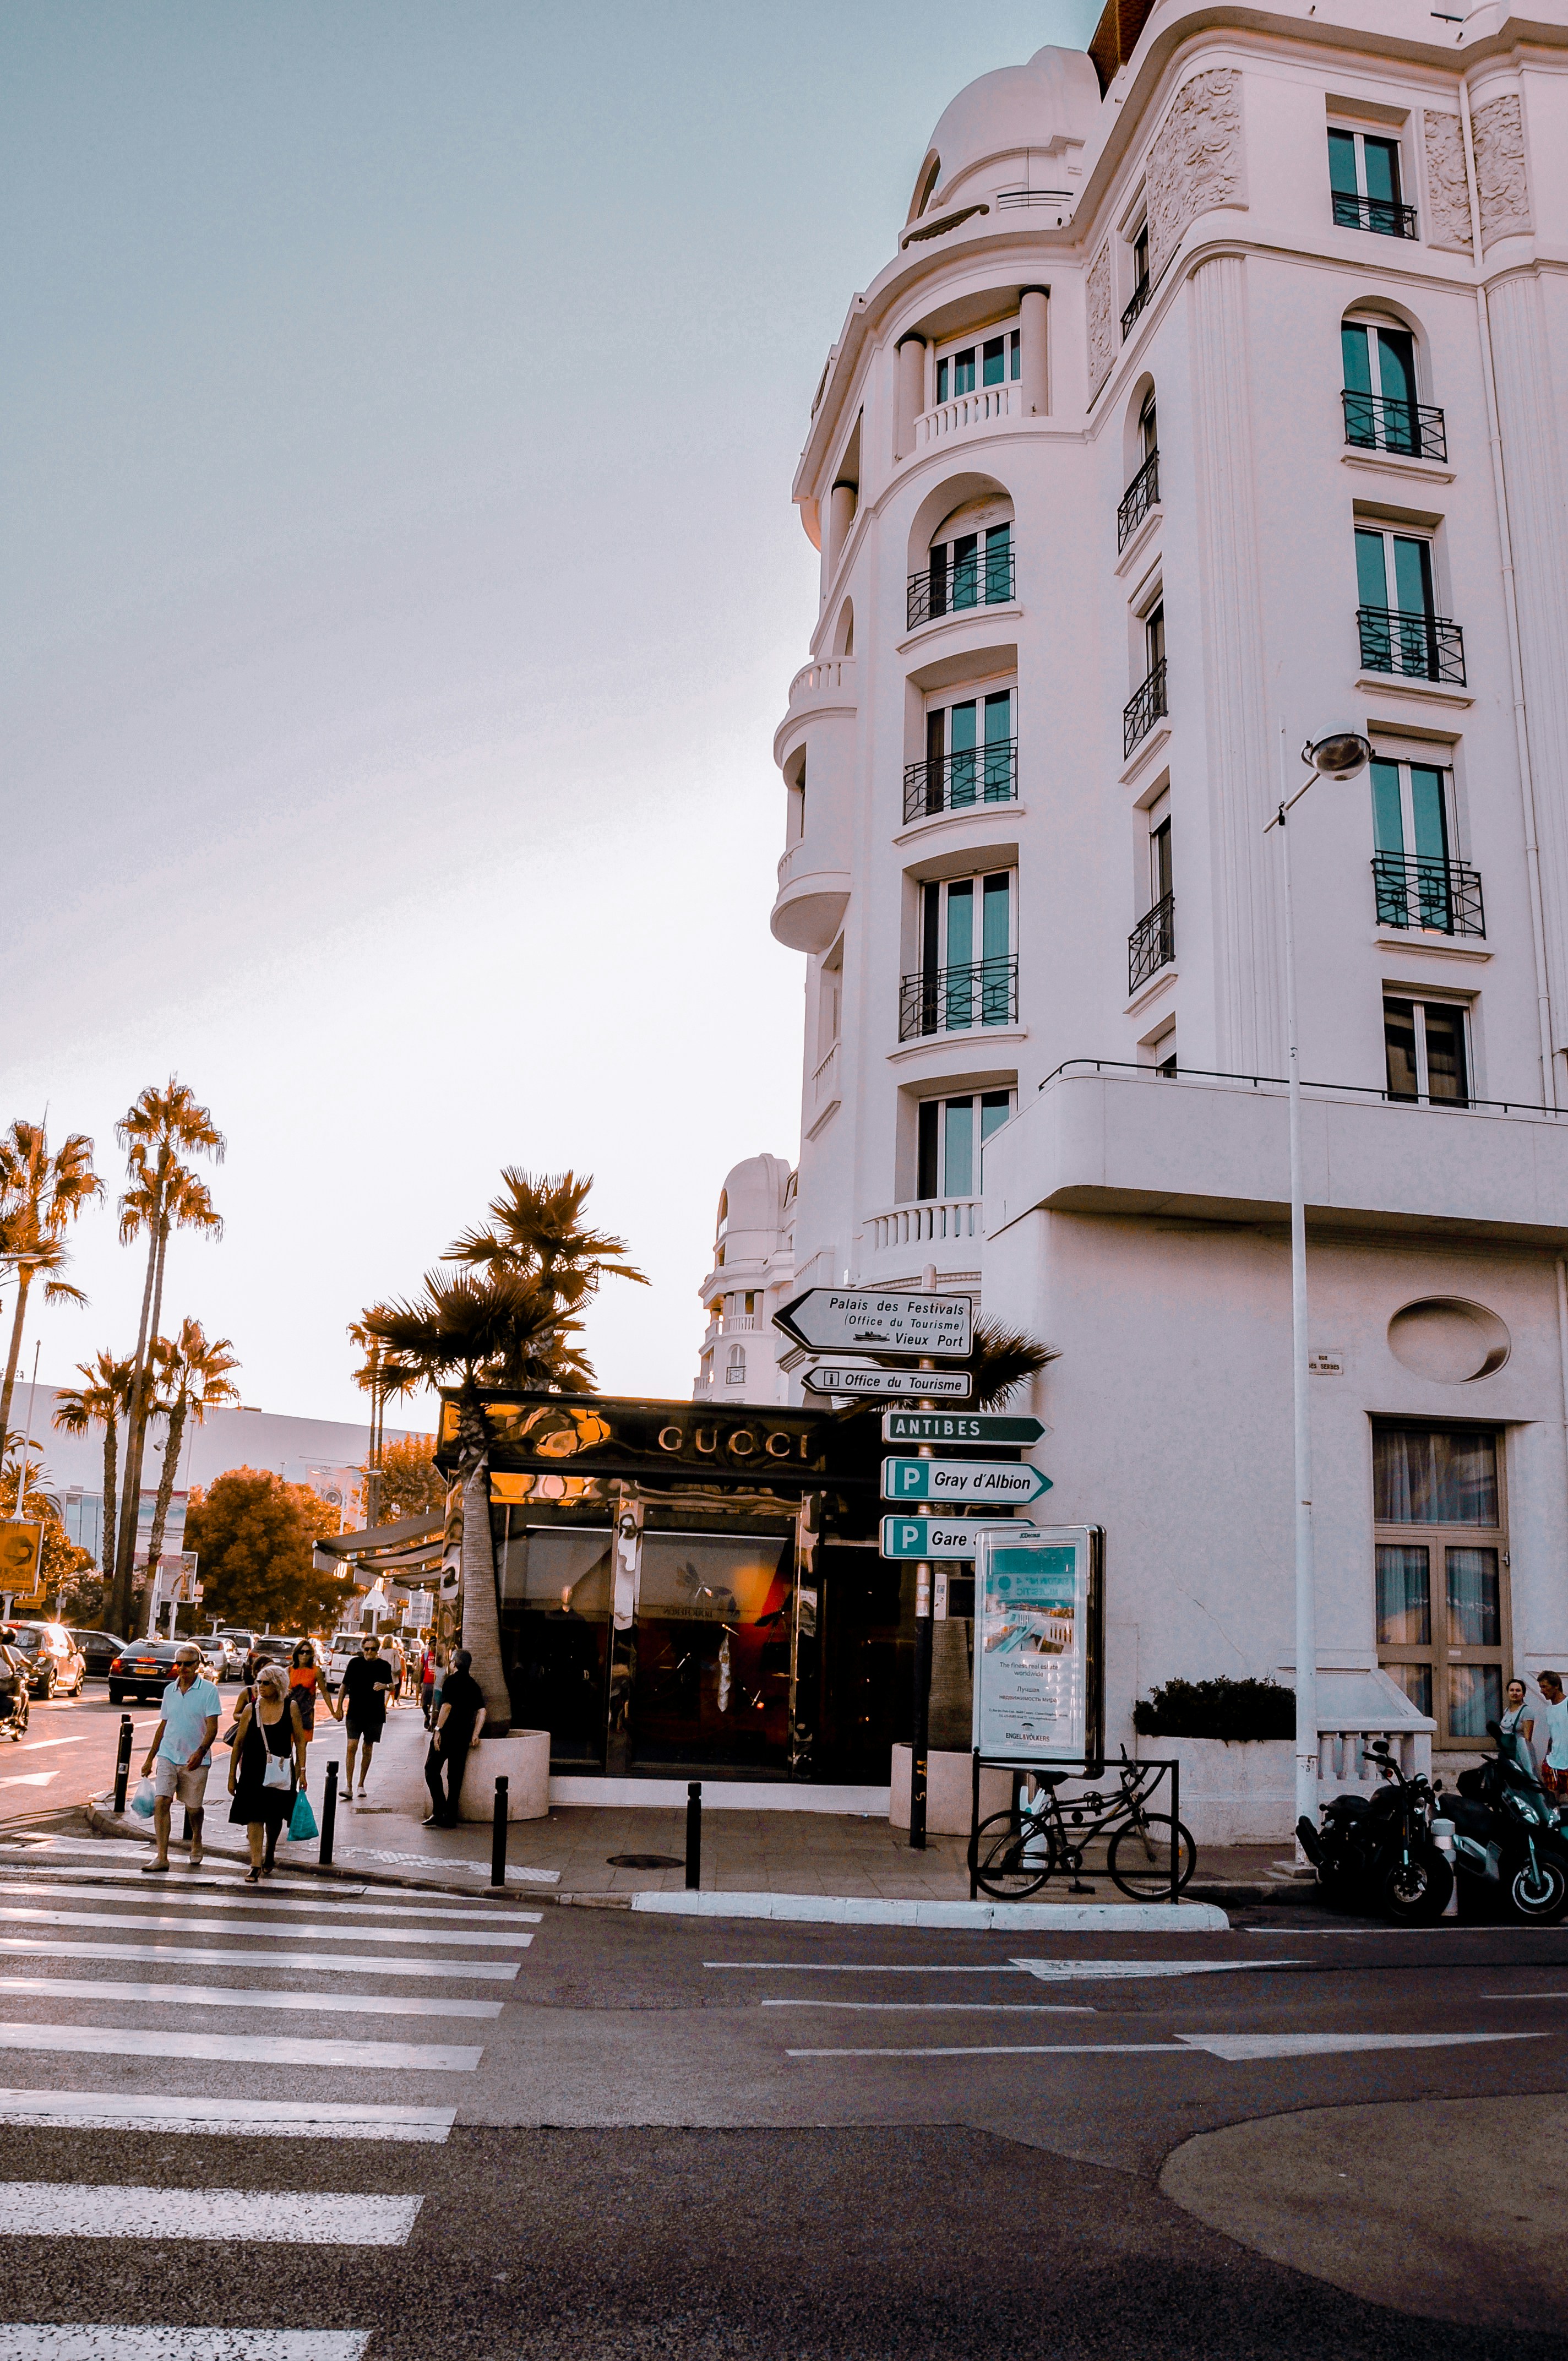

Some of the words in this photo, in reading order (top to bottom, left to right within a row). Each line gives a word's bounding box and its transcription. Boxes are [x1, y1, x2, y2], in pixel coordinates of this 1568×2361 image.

[829, 1297, 868, 1311] Palais
[876, 1300, 899, 1312] des
[907, 1301, 964, 1315] Festivals
[845, 1313, 883, 1326] (Office
[890, 1318, 903, 1328] du
[911, 1318, 964, 1332] Tourisme)
[895, 1332, 929, 1345] Vieux
[937, 1335, 963, 1347] Port
[845, 1374, 880, 1387] Office
[888, 1377, 901, 1388] du
[909, 1377, 962, 1391] Tourisme
[895, 1419, 980, 1436] ANTIBES
[658, 1426, 808, 1458] GUCCI
[903, 1467, 920, 1490] P
[934, 1471, 968, 1490] Gray
[973, 1473, 1031, 1490] d'Albion
[902, 1525, 919, 1549] P
[932, 1531, 967, 1546] Gare
